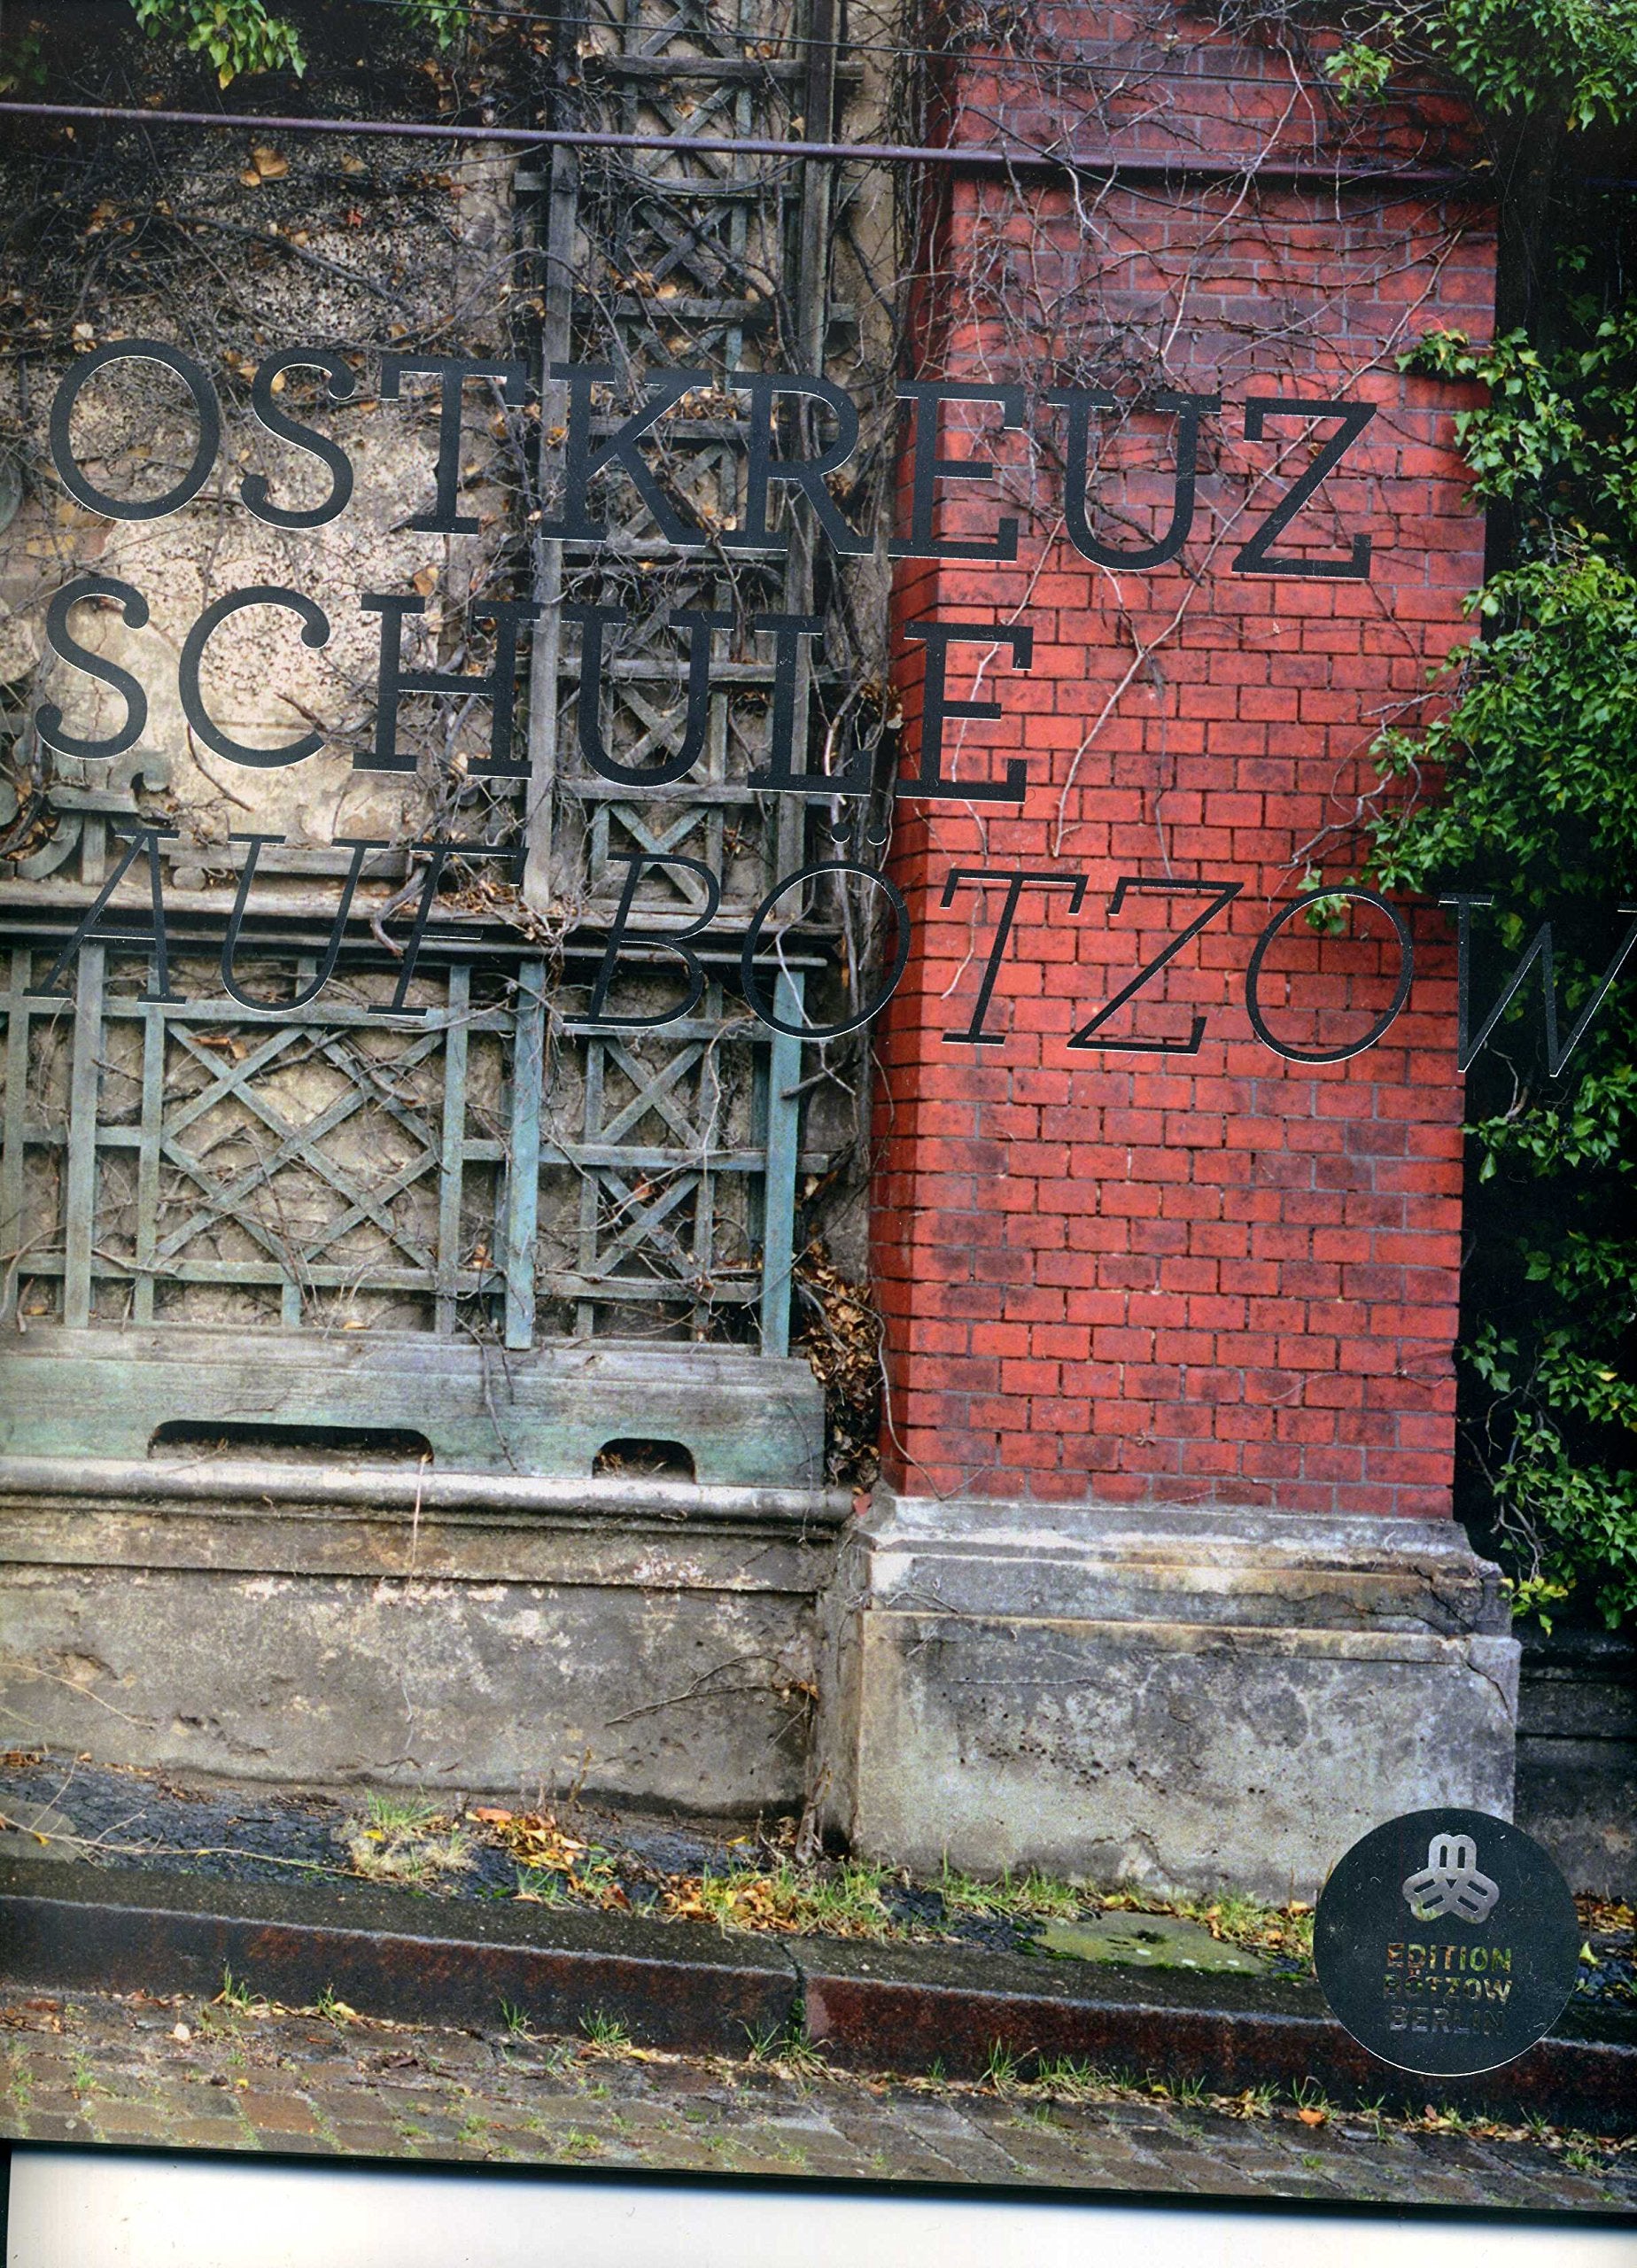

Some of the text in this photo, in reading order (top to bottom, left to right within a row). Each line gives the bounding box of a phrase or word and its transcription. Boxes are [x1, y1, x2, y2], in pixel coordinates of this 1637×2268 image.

[50, 338, 1377, 580] OSTKREUZ
[35, 577, 1033, 804] SCHULE
[23, 822, 1637, 1078] AUF BÖTZOW
[1387, 1942, 1512, 1973] EDITION
[1389, 2006, 1504, 2035] BERLIN
